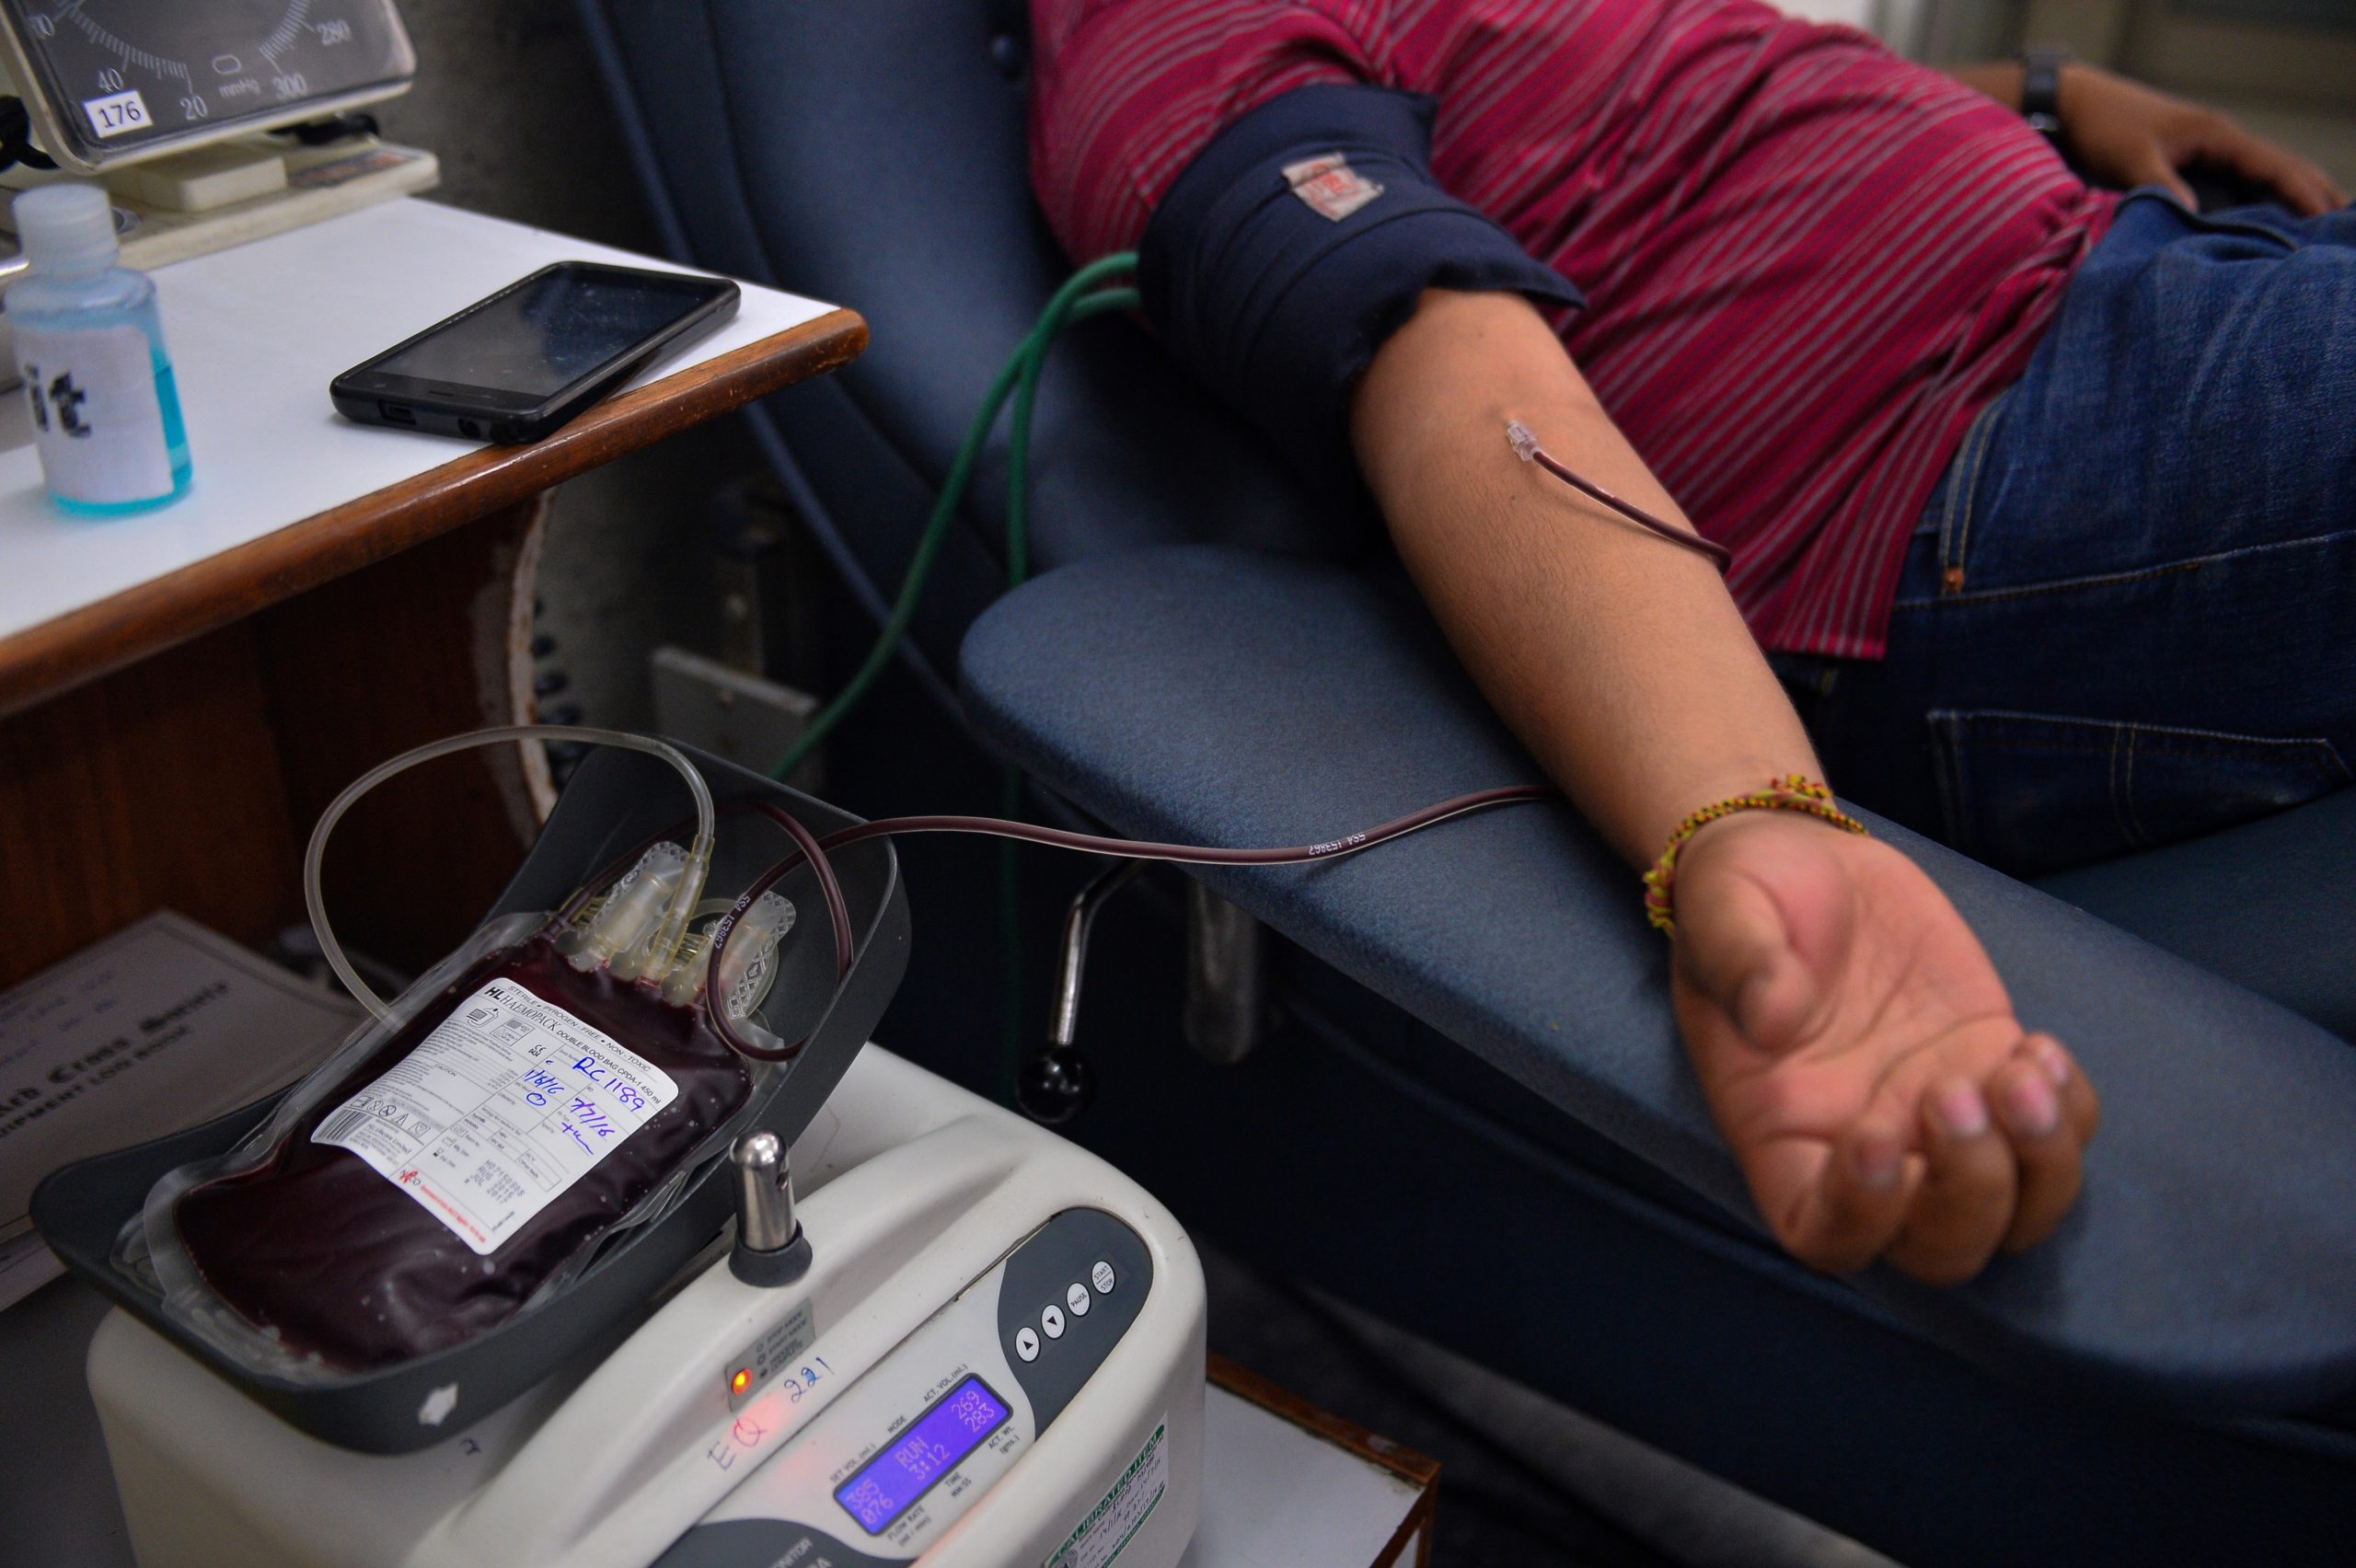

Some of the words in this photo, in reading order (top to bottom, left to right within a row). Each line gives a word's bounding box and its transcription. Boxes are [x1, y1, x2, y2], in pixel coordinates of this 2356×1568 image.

[318, 18, 352, 46] 280
[98, 68, 123, 91] 40
[218, 76, 260, 98] mmHg
[272, 73, 308, 101] 300
[98, 101, 141, 129] 176
[180, 95, 208, 121] 20
[508, 986, 537, 1006] STERILE
[543, 1006, 578, 1027] PYROGEN
[581, 1027, 602, 1041] FREE
[606, 1043, 624, 1055] NON
[628, 1055, 651, 1072] TOXIC
[499, 995, 561, 1032] HAEMOPACK
[556, 1030, 583, 1048] DOUBLE
[582, 1045, 605, 1061] BLOOD
[603, 1058, 619, 1071] BAG
[618, 1068, 642, 1087] CPDA-1
[641, 1085, 653, 1097] 450
[572, 1056, 606, 1082] RC
[603, 1078, 645, 1112] 1189
[1094, 1265, 1109, 1280] START
[1101, 1278, 1113, 1290] STOP
[1070, 1292, 1087, 1308] PAUSE
[783, 1356, 835, 1403] 221
[923, 1389, 939, 1402] ACT.
[886, 1415, 907, 1435] MODE
[895, 1436, 929, 1469] RUN
[951, 1390, 979, 1420] 269
[988, 1435, 1003, 1450] ACT.
[861, 1493, 895, 1525] 076
[908, 1443, 951, 1482] 3:12
[964, 1402, 994, 1433] 283
[944, 1472, 962, 1488] TIME
